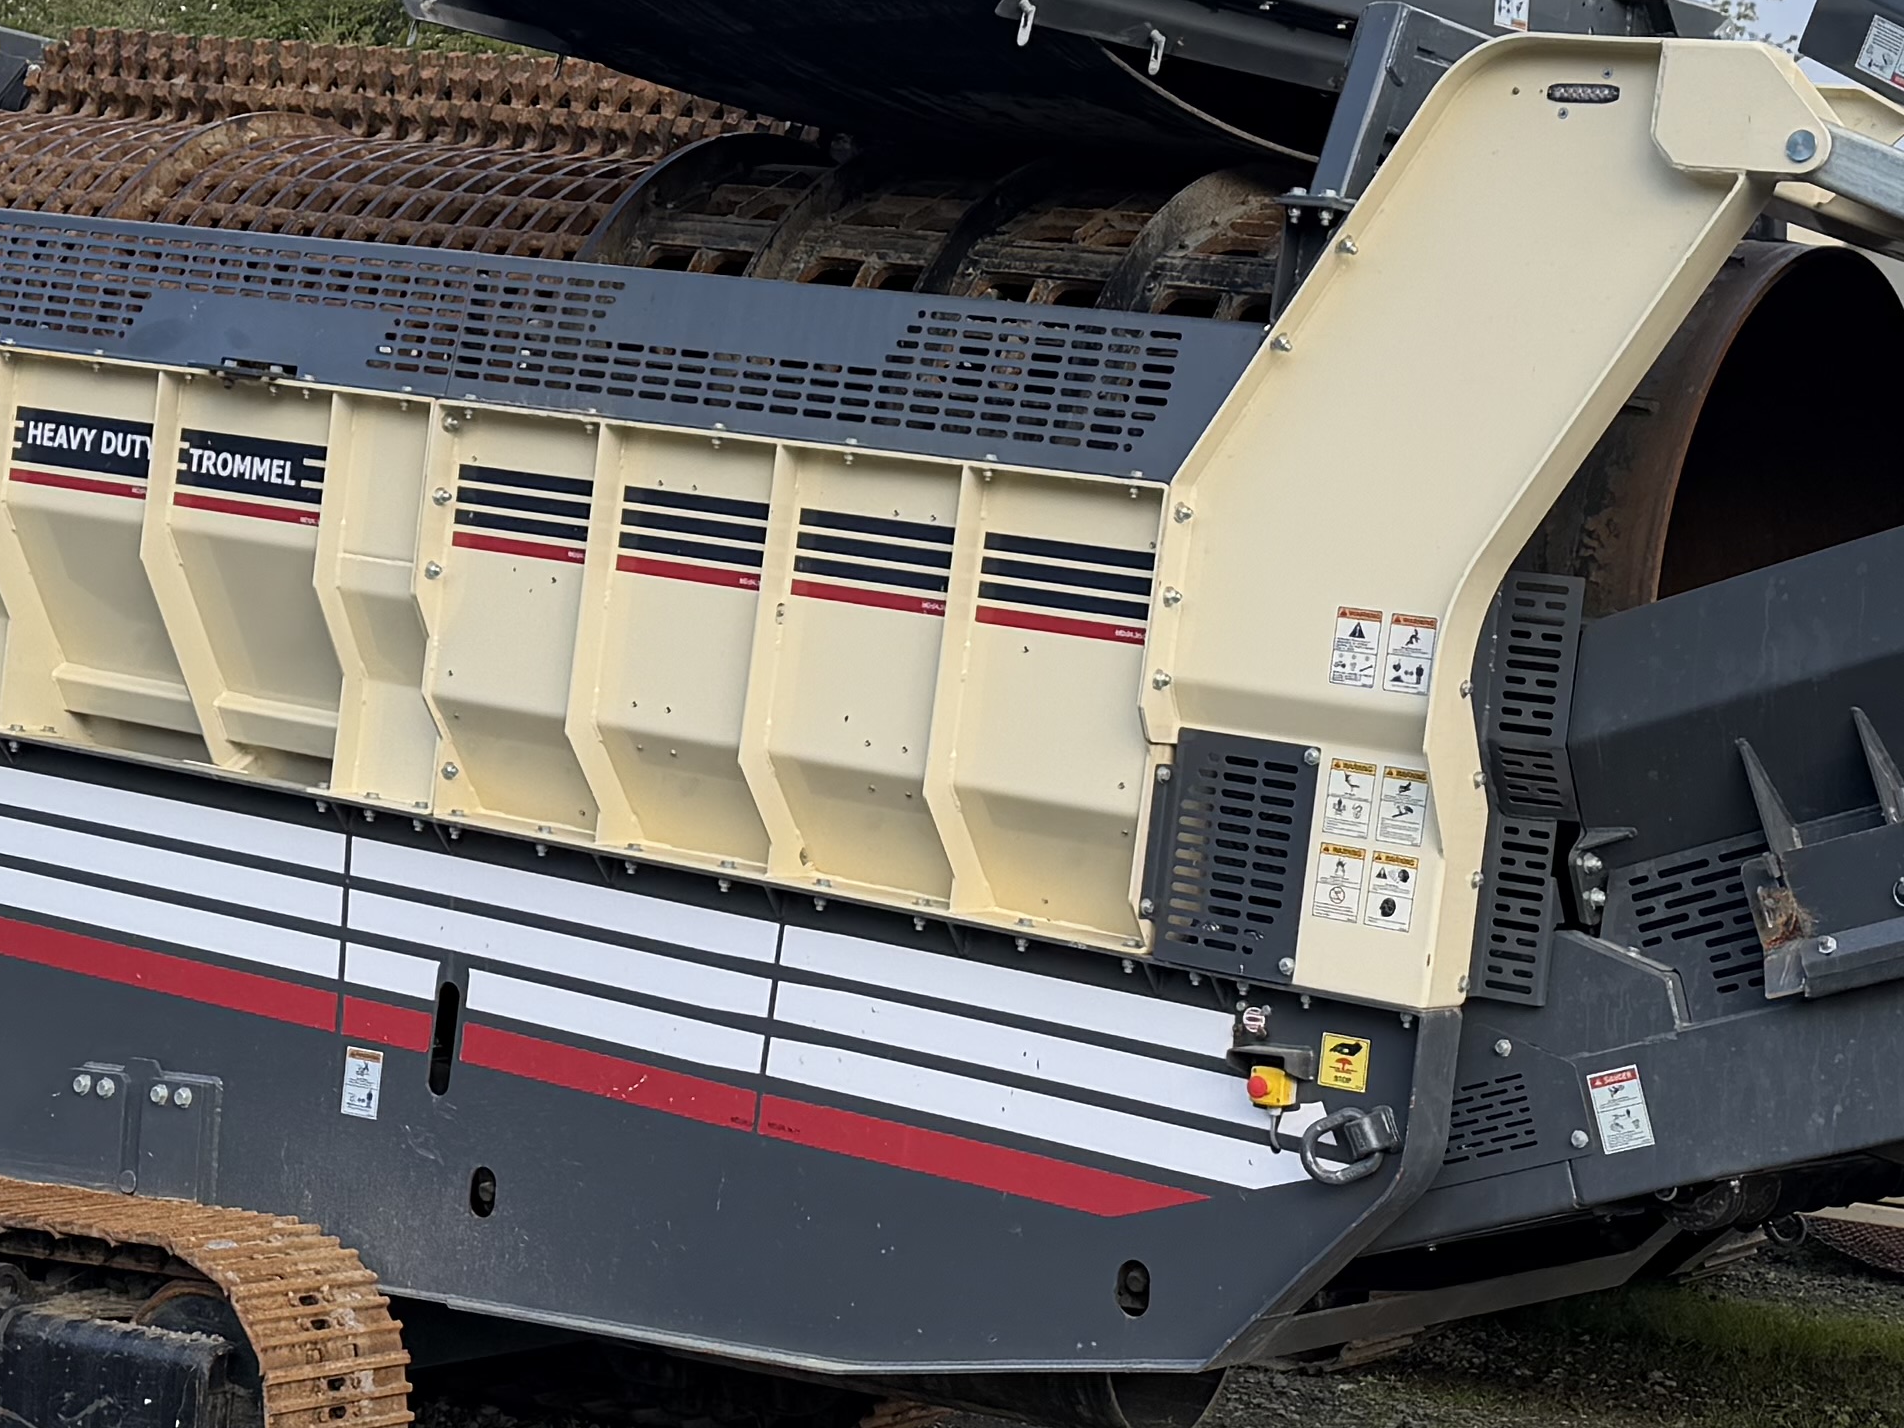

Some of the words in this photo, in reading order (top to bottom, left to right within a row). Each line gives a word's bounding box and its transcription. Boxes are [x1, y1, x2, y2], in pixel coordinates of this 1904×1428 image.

[26, 420, 98, 453] HEAVY
[100, 429, 153, 460] DUTY
[188, 447, 297, 487] TROMMEL
